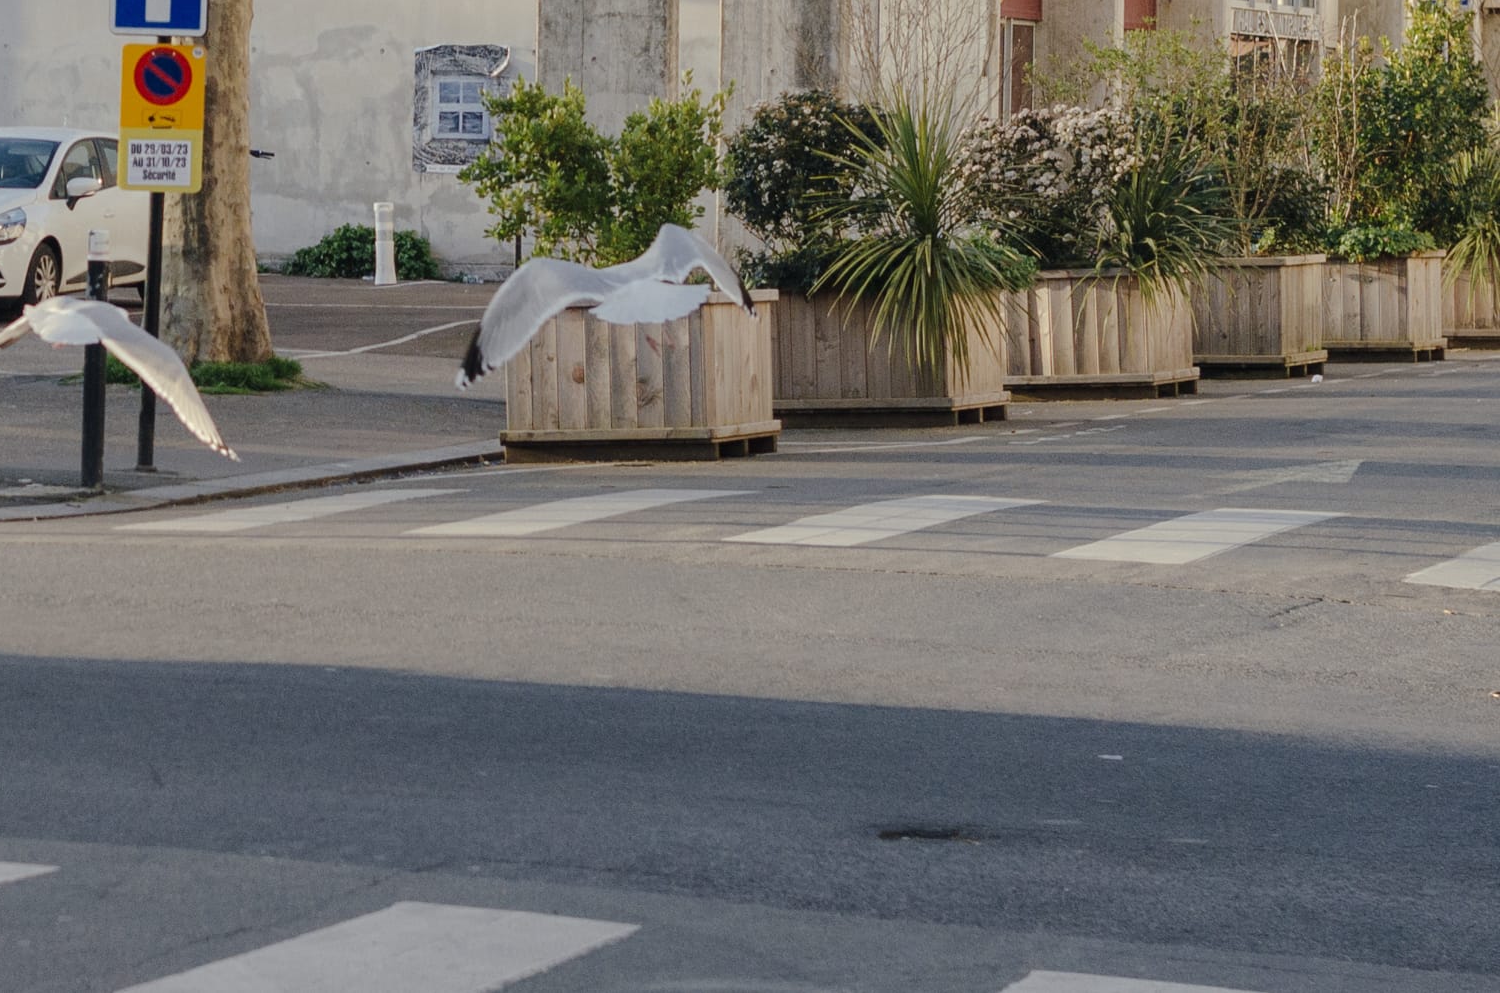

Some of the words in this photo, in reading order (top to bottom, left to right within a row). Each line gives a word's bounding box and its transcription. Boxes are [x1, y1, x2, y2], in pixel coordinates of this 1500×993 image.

[131, 143, 142, 155] DU
[132, 157, 144, 168] AU
[146, 157, 187, 168] 31/10/23
[142, 169, 176, 181] Sécurité
